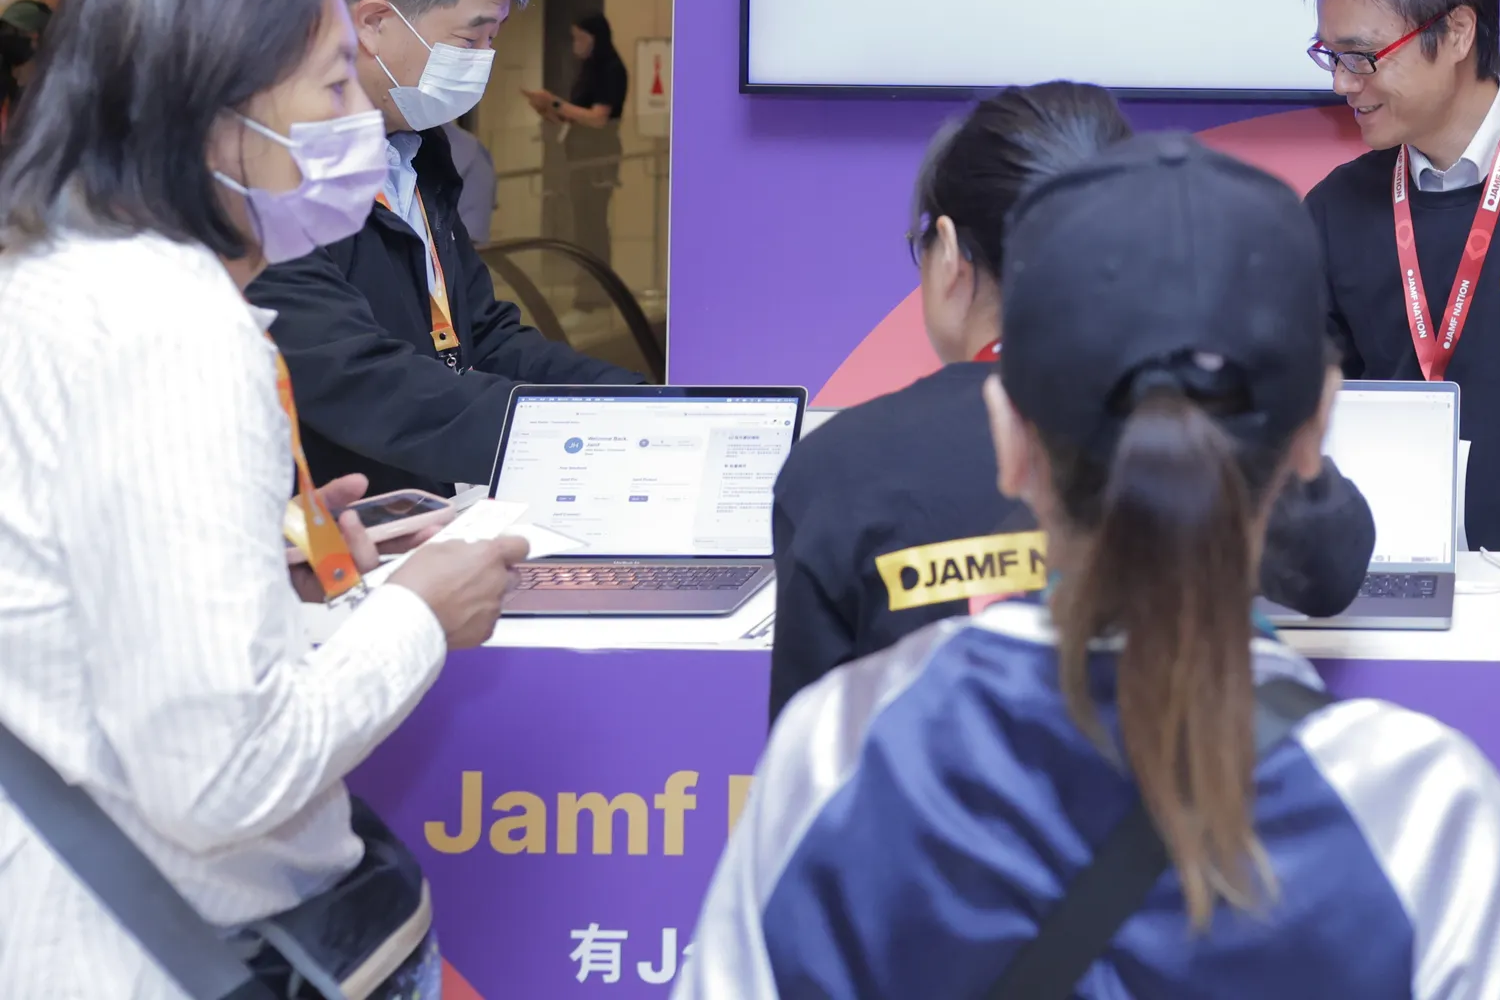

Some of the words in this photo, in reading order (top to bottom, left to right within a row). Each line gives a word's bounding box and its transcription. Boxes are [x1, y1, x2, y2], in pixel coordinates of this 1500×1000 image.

[1408, 278, 1418, 300] JAMF
[1412, 302, 1427, 338] NATION
[1447, 317, 1459, 342] JAMF
[1454, 280, 1470, 316] NATION
[924, 550, 1018, 588] JAMF
[424, 770, 699, 855] Jamf
